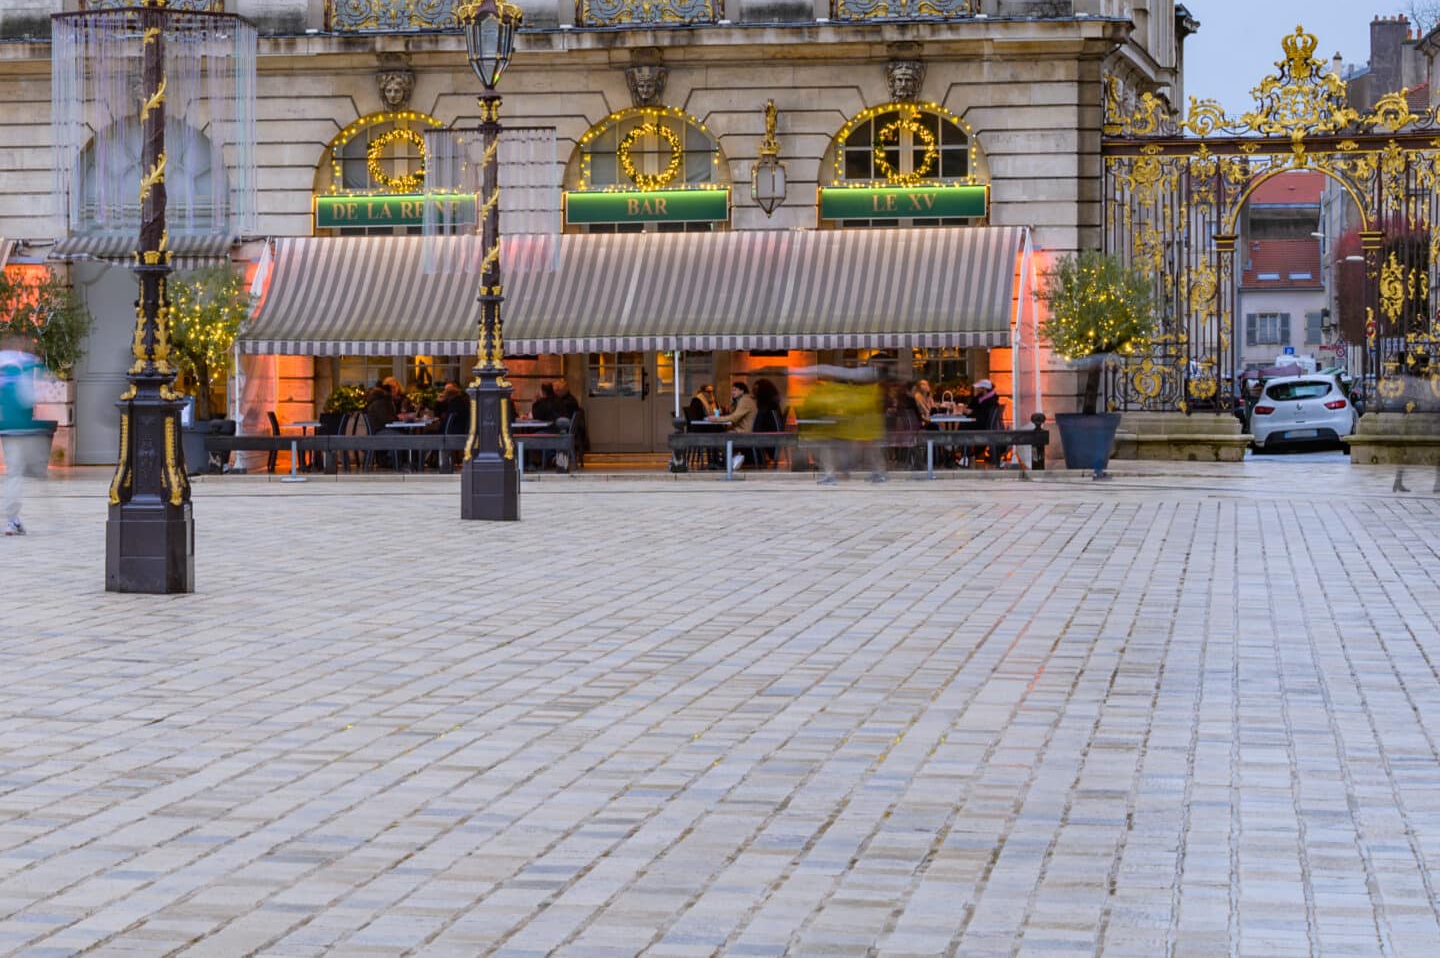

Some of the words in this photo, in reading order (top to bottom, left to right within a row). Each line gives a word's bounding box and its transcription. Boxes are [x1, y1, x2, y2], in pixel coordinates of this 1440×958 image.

[333, 202, 358, 220] DE
[367, 202, 392, 219] LA
[627, 197, 668, 215] BAR
[873, 194, 897, 211] LE
[908, 193, 936, 210] XV
